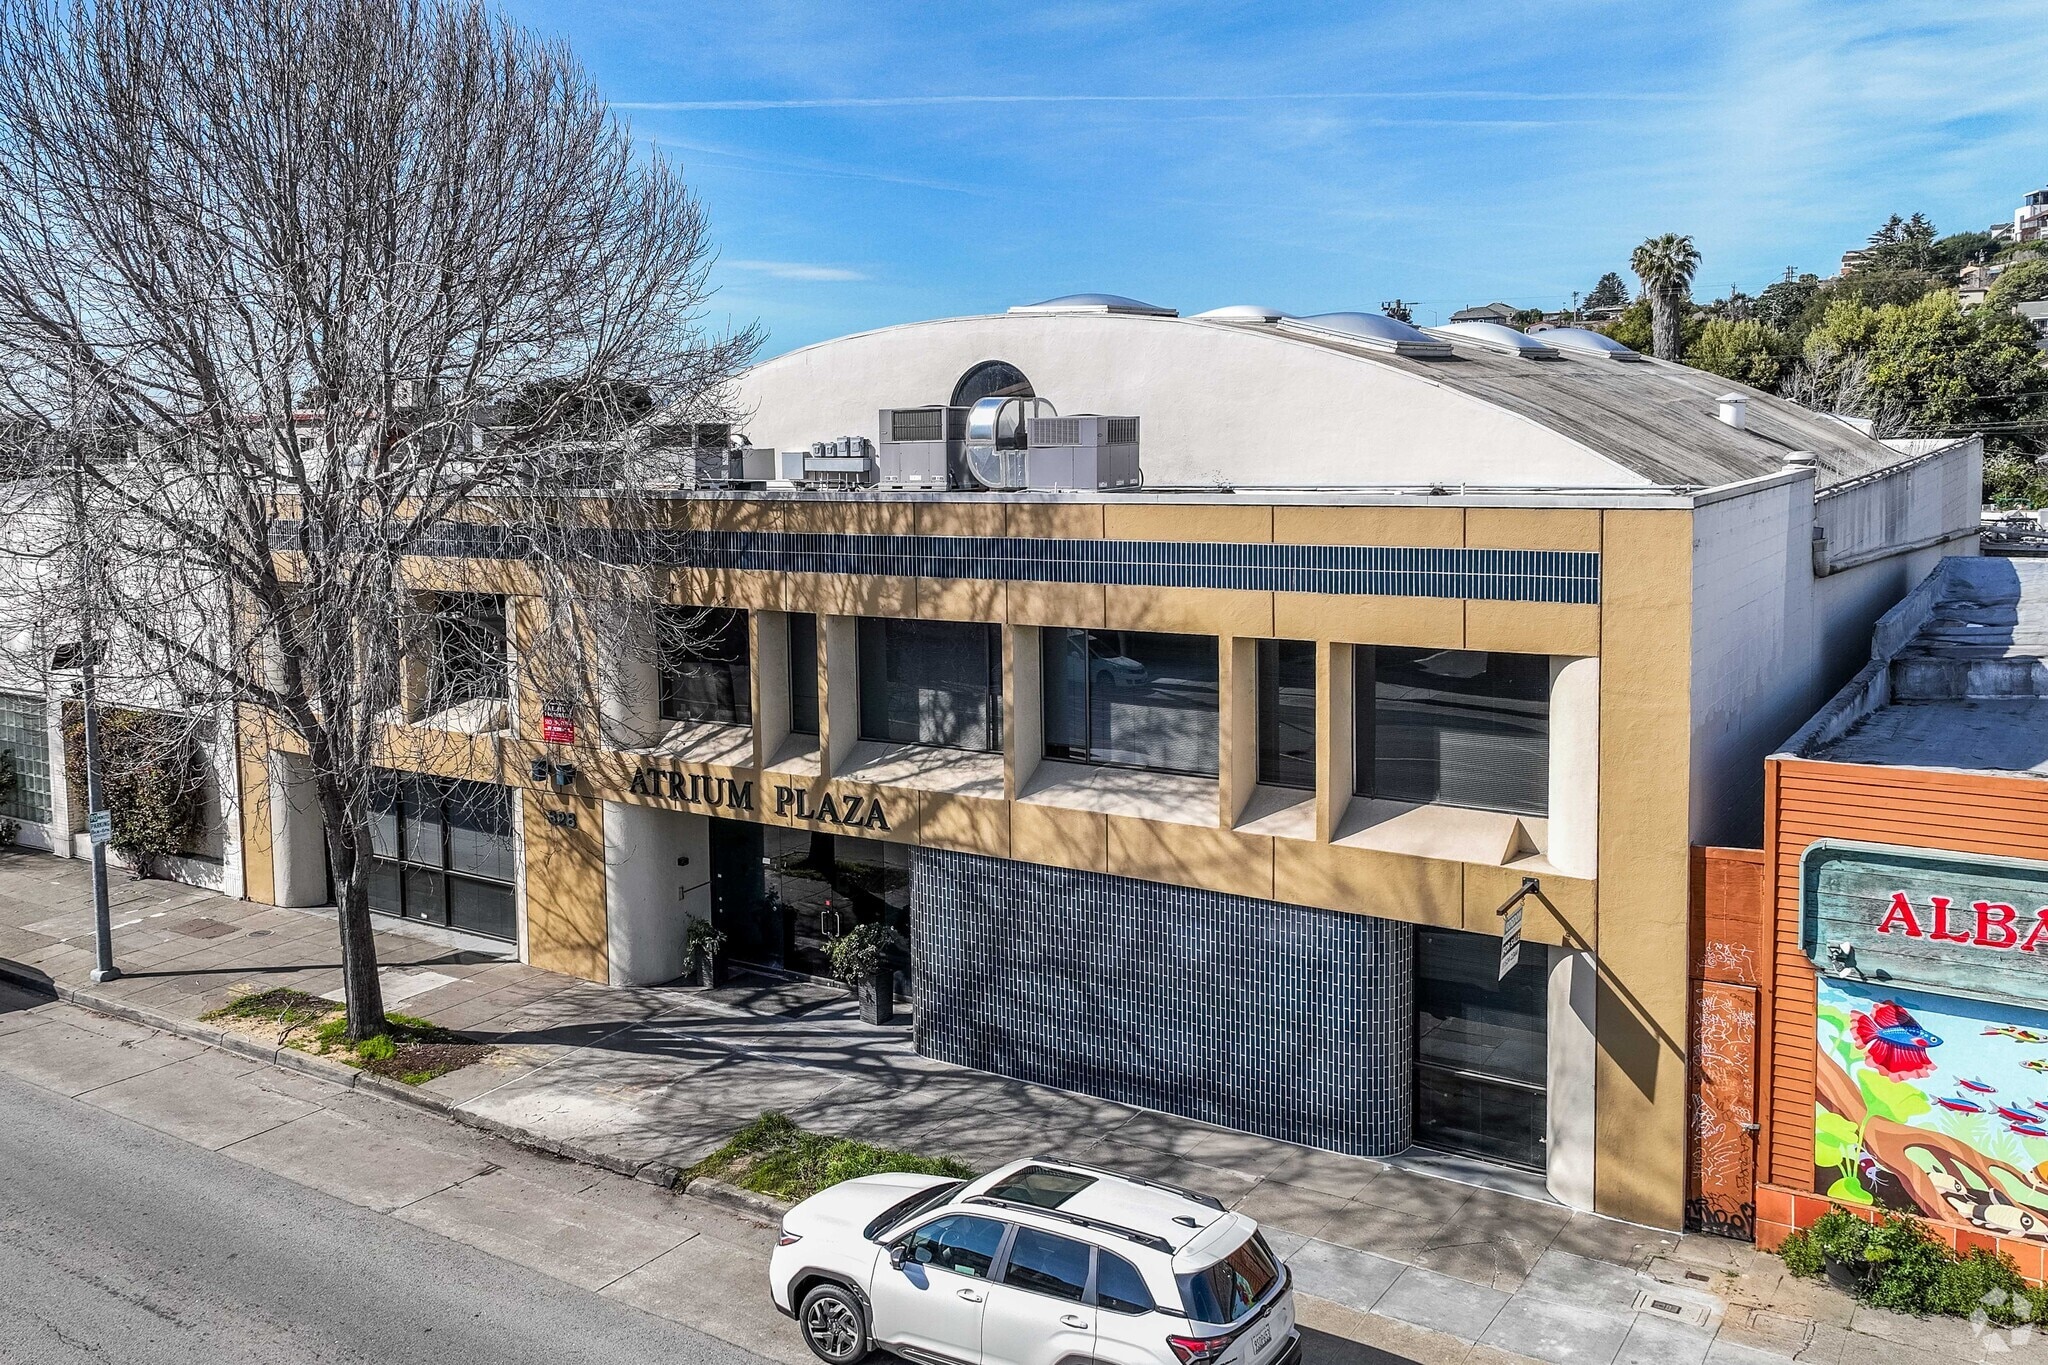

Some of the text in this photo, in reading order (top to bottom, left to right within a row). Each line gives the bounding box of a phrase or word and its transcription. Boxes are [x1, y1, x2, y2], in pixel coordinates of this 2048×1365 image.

[629, 766, 891, 830] ATRIUM PLAZA
[91, 821, 109, 829] PARKING
